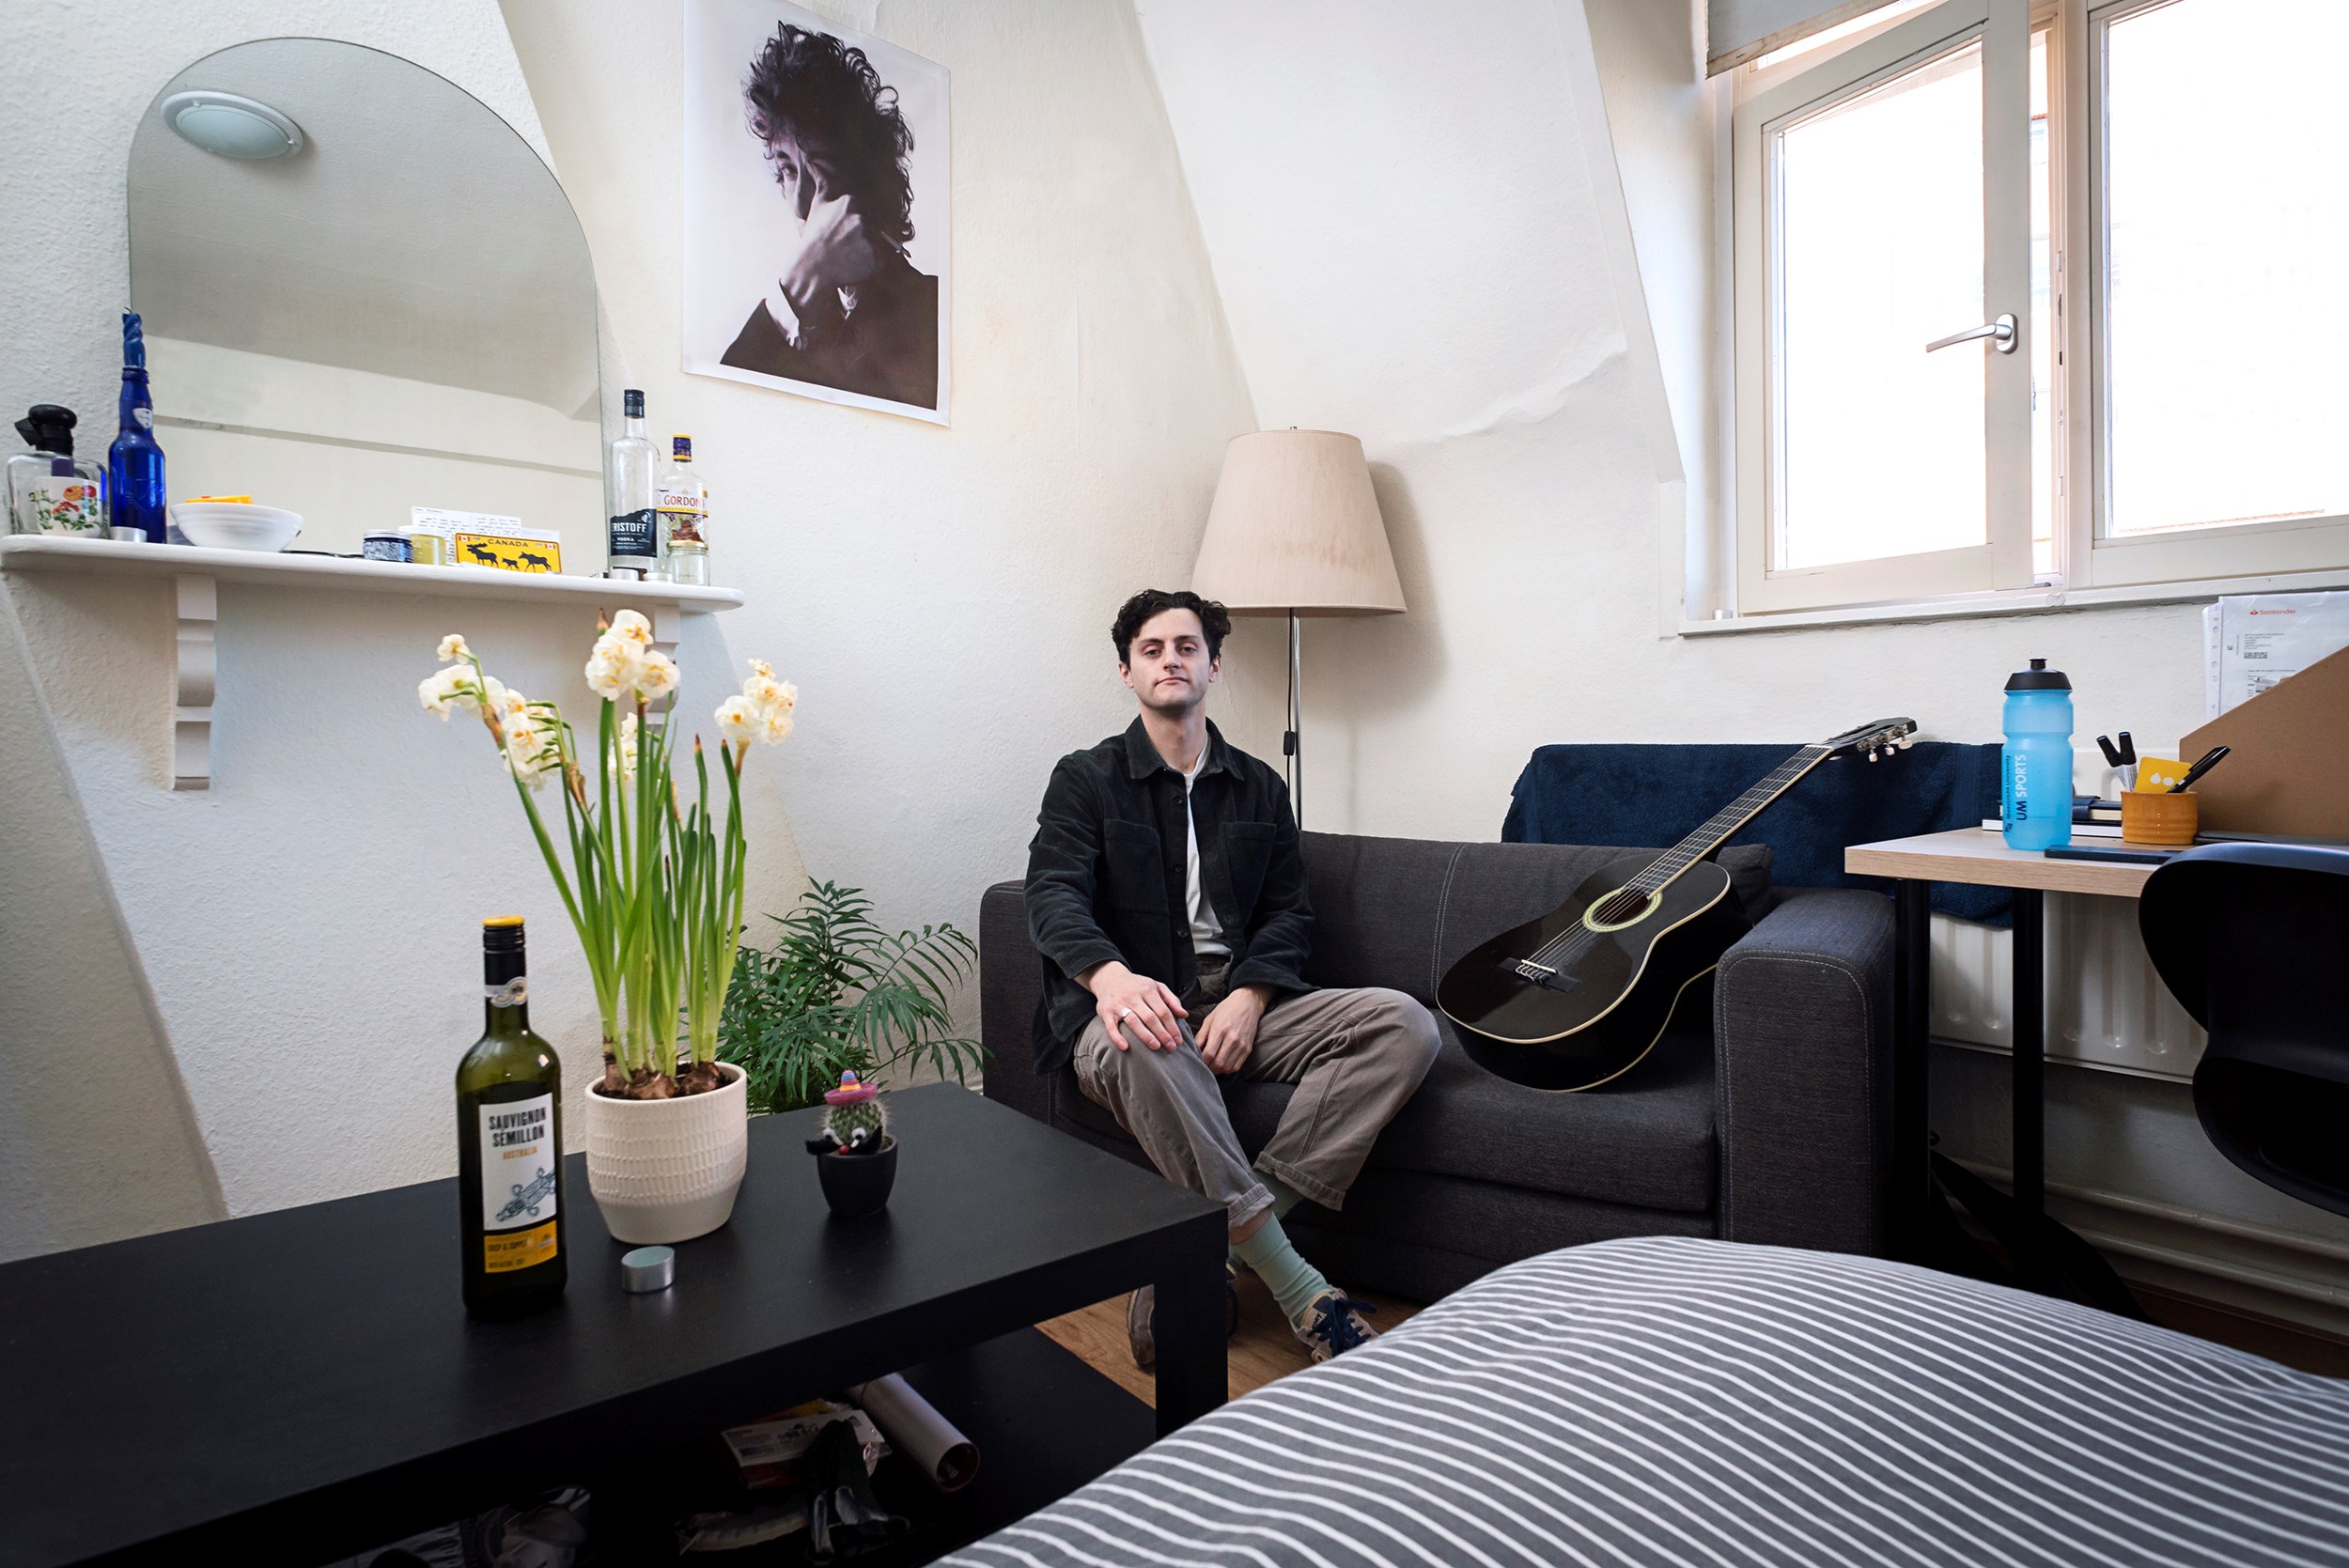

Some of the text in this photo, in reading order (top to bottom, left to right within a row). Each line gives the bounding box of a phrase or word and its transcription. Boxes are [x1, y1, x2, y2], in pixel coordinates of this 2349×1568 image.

[487, 538, 529, 548] CANADA
[2015, 754, 2028, 821] UM SPORTS
[489, 1107, 547, 1130] SAUVIGNON
